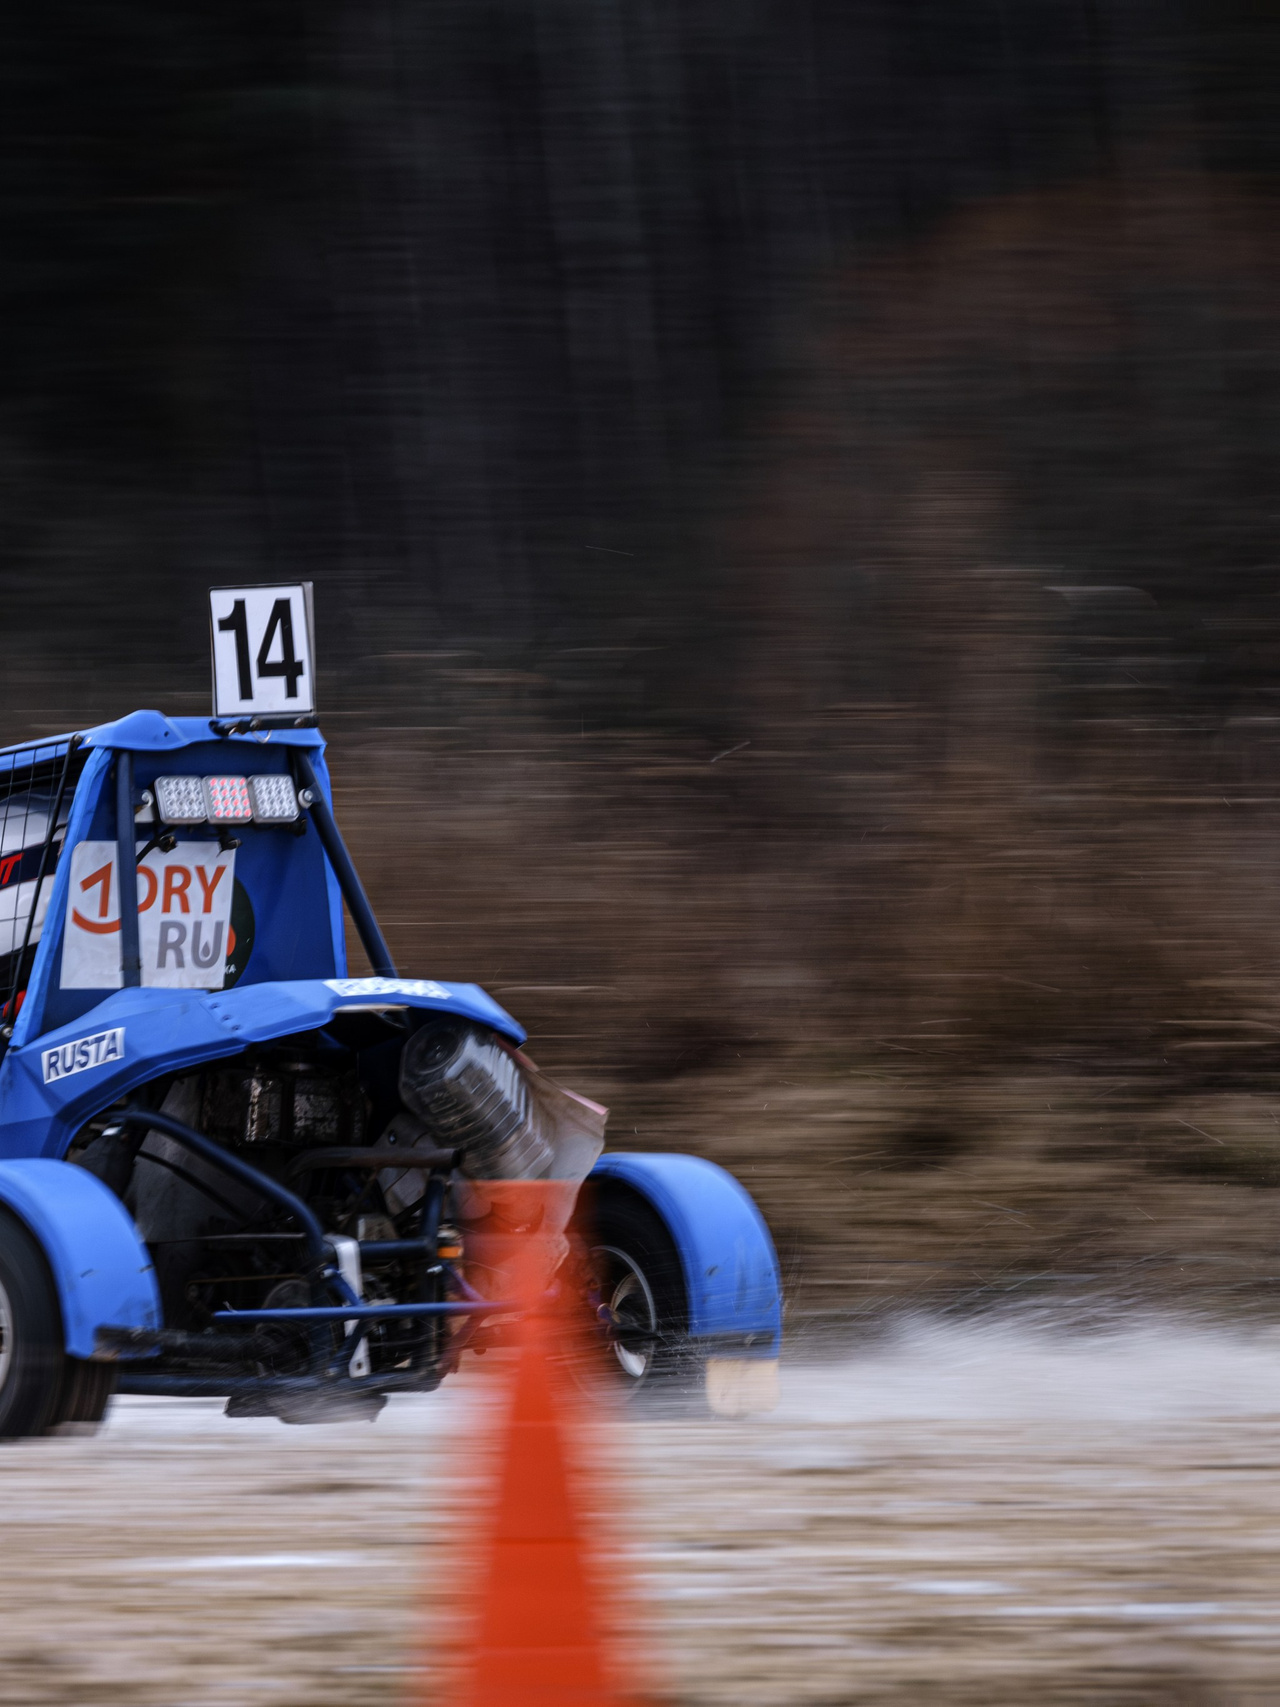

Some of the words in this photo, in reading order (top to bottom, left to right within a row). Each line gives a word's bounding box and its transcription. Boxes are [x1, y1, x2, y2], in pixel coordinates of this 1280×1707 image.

[218, 598, 304, 702] 14
[156, 920, 225, 969] RU
[46, 1031, 120, 1082] RUSTA
